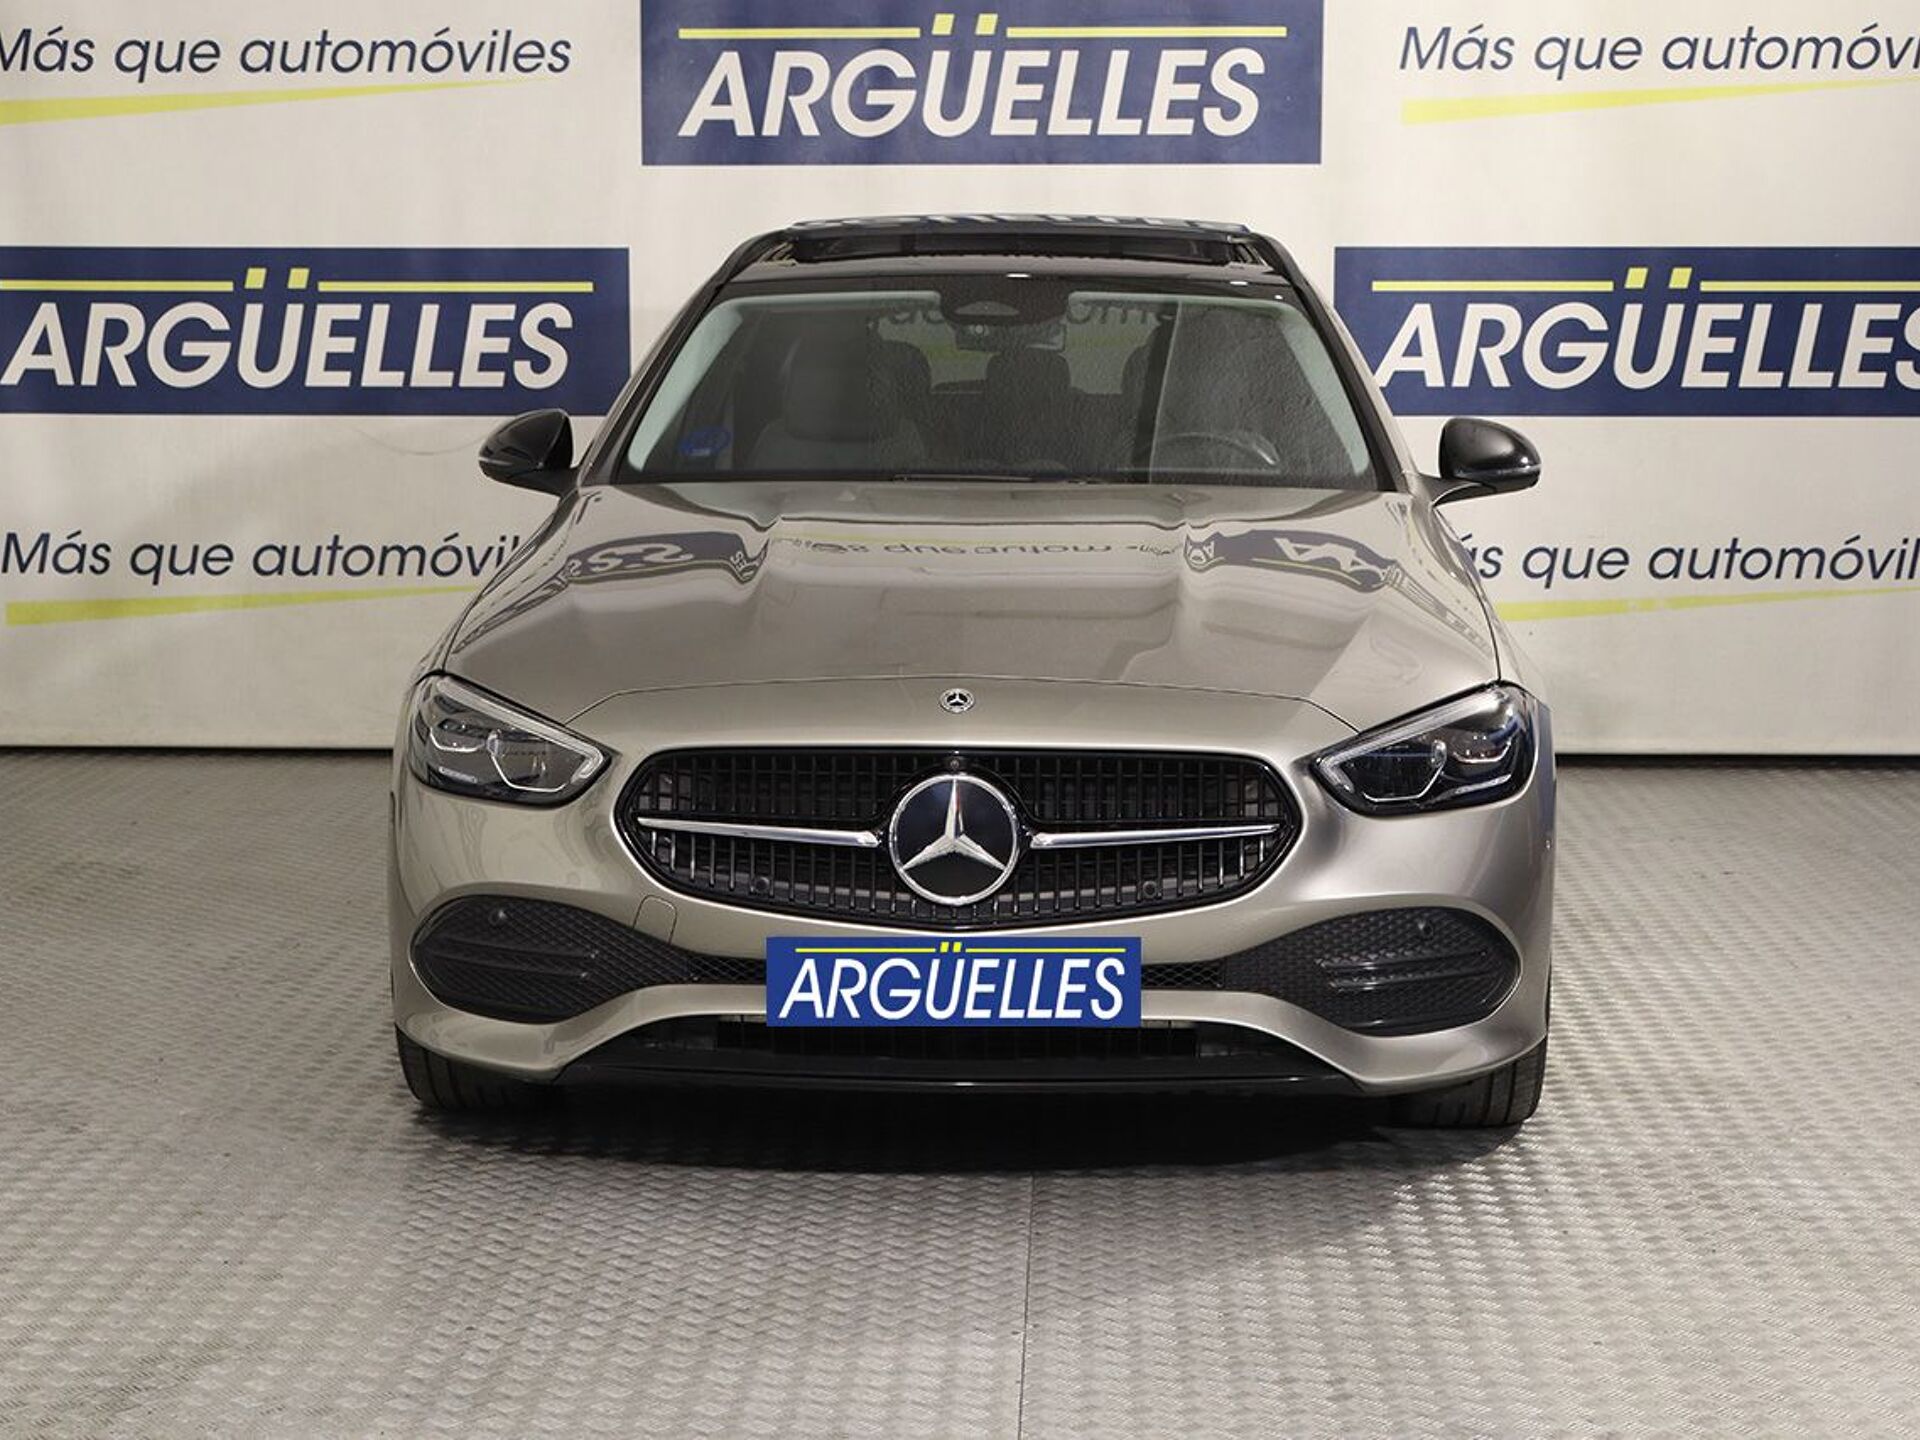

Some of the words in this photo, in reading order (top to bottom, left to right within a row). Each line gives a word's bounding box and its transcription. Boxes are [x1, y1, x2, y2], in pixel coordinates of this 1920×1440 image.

[0, 25, 95, 73] Más
[114, 39, 221, 84] que
[239, 26, 572, 74] automóviles
[677, 13, 1265, 138] ARGÜELLES
[1399, 23, 1515, 71] Más
[1534, 36, 1643, 81] que
[2, 267, 574, 389] ARGÜELLES
[1, 529, 112, 576] Más
[129, 543, 234, 586] que
[1522, 546, 1630, 590] que
